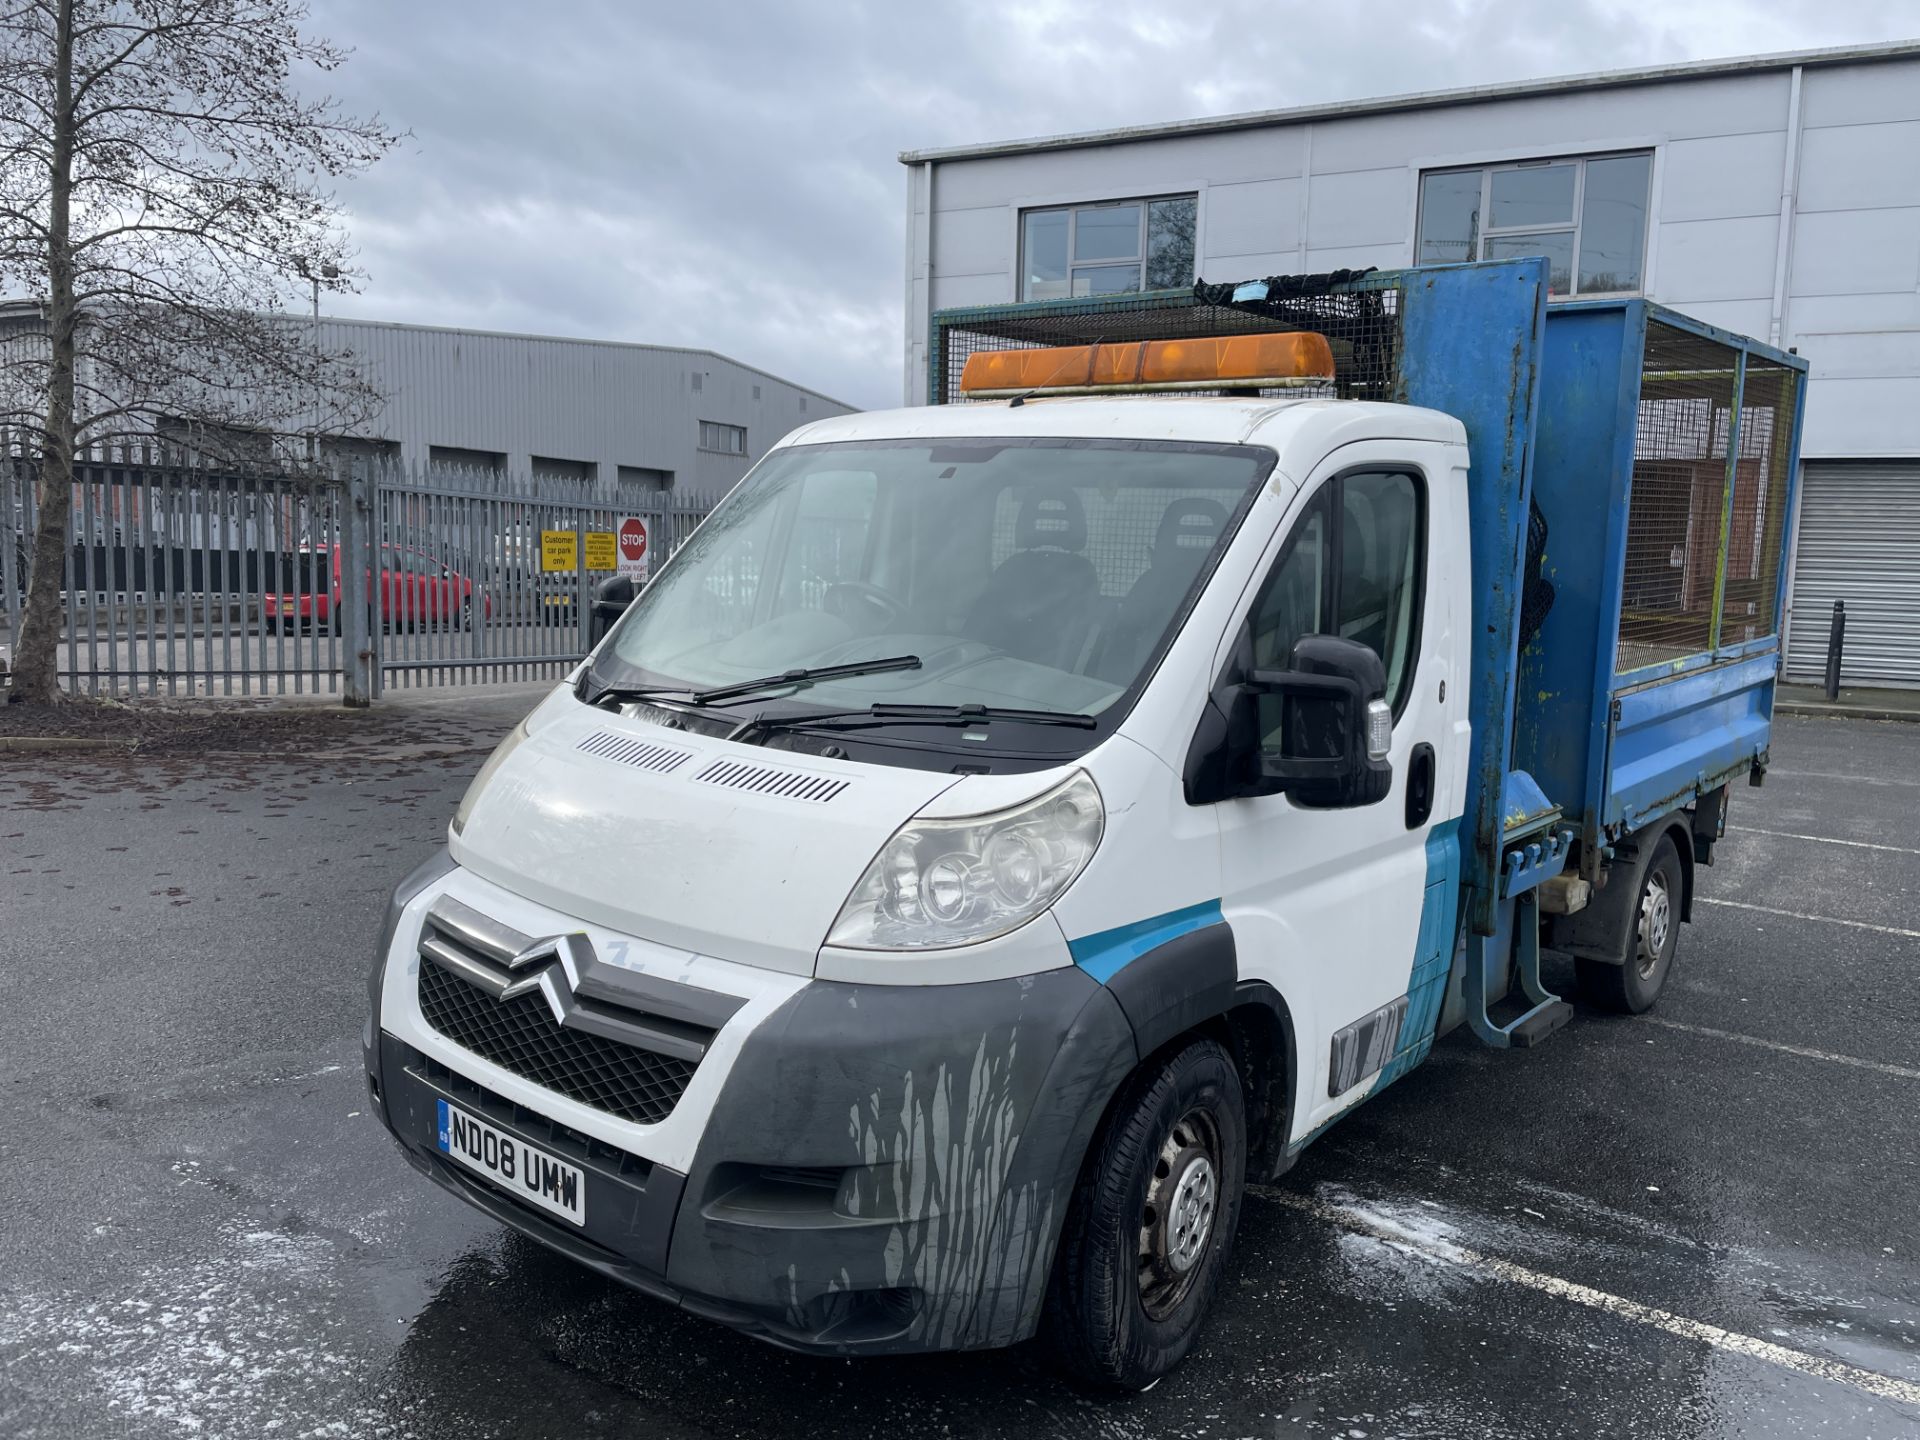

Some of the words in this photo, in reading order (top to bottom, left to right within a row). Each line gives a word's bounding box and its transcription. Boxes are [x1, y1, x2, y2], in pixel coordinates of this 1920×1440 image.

[545, 536, 574, 544] Customer
[622, 534, 644, 546] STOP
[557, 547, 571, 555] park
[553, 557, 565, 566] only
[453, 1111, 515, 1179] ND08
[524, 1148, 577, 1212] UMW
